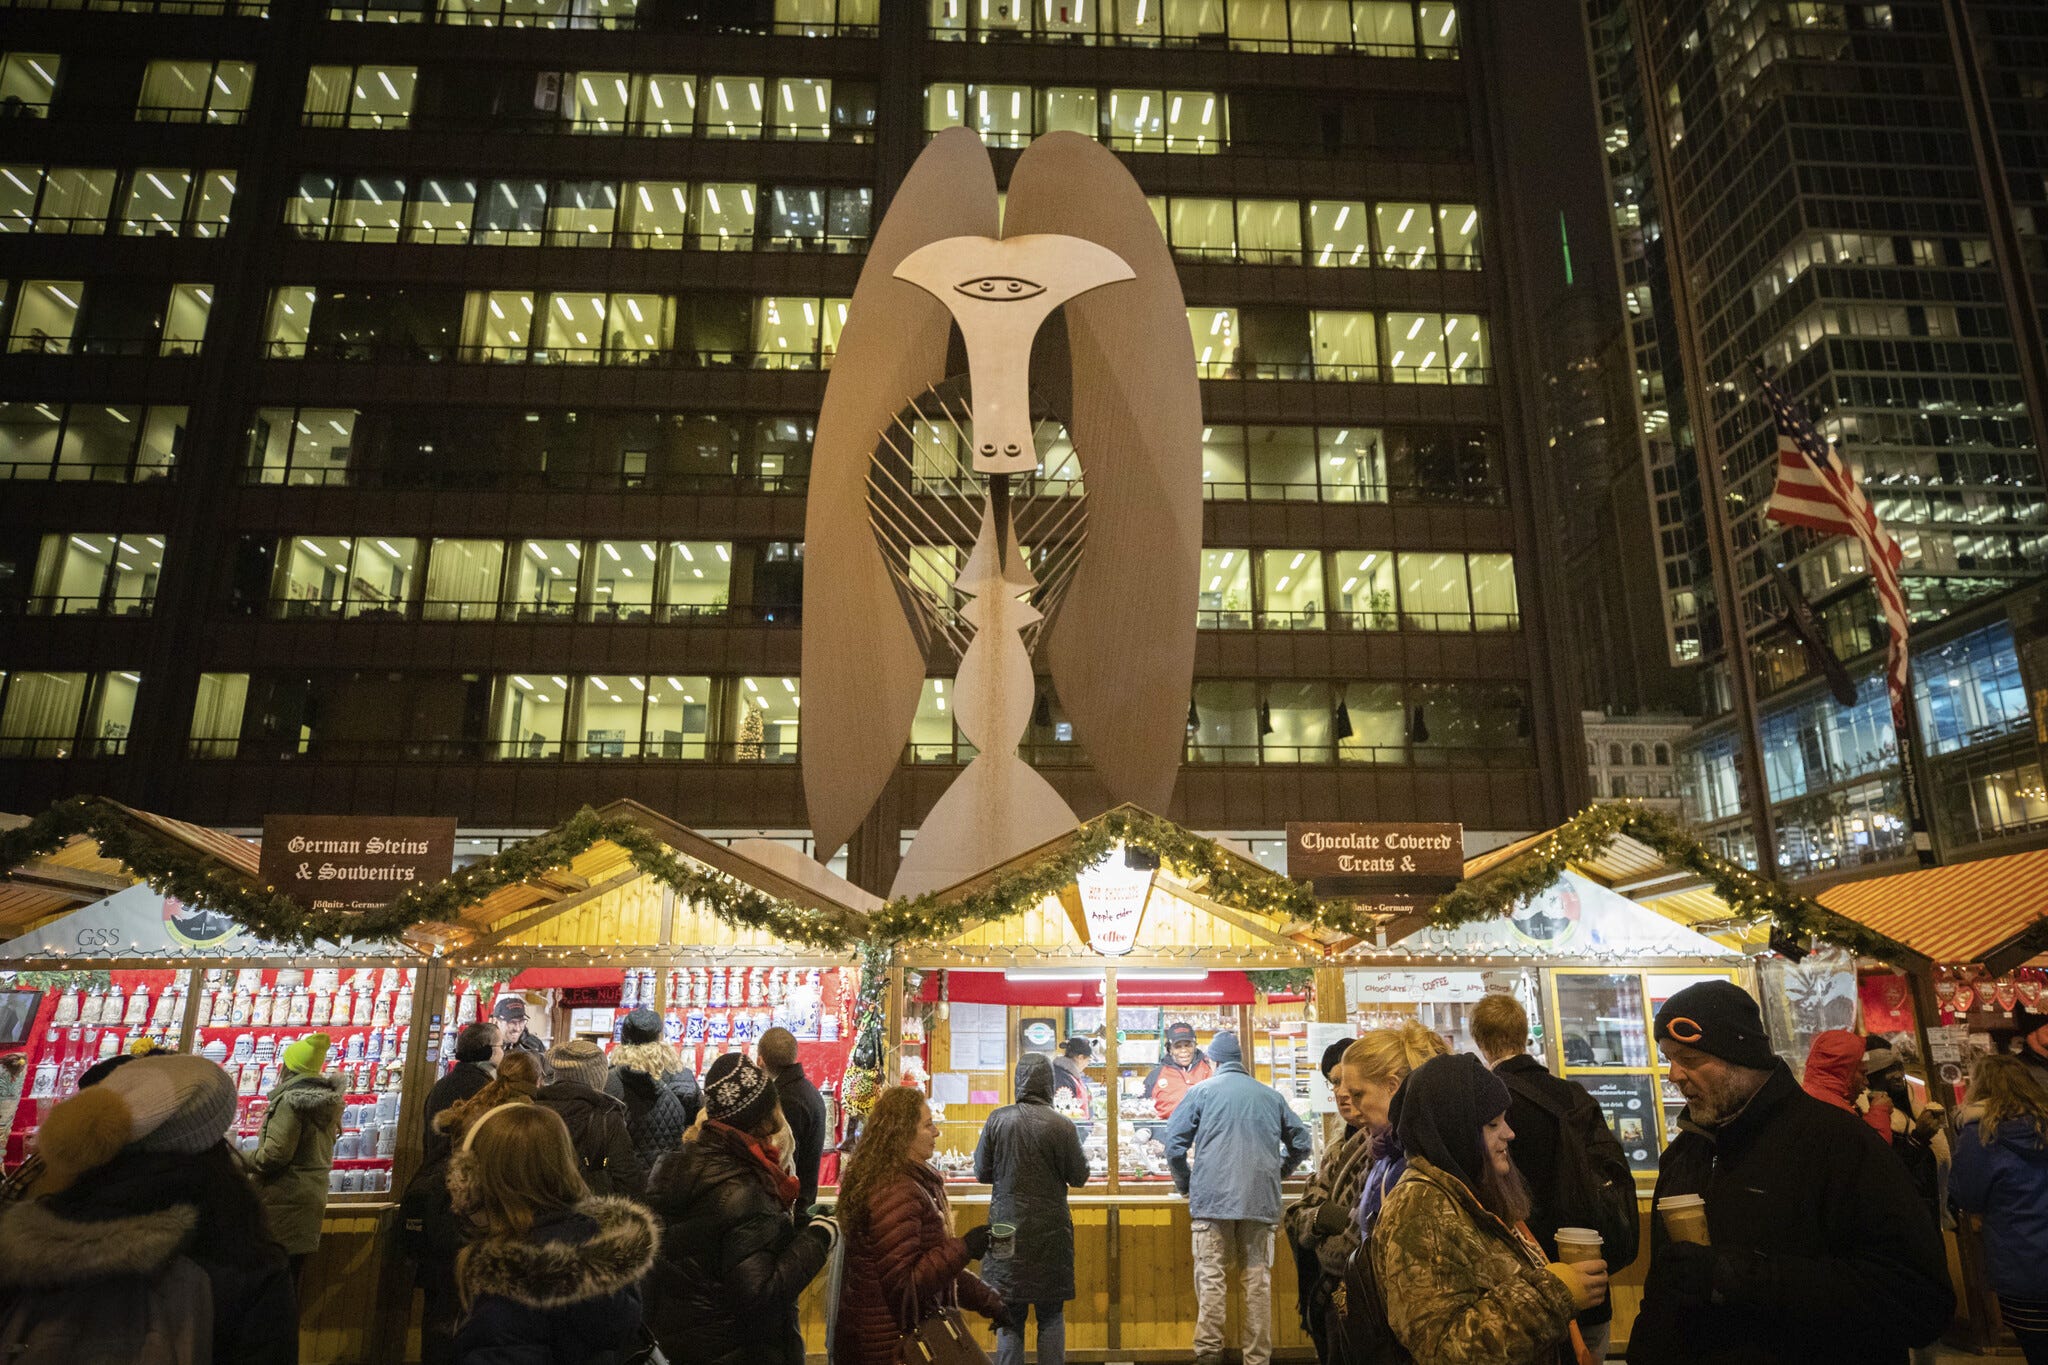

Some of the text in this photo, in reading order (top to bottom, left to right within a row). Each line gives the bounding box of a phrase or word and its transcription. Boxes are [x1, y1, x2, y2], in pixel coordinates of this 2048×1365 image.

[287, 835, 429, 855] German Steins
[1300, 832, 1452, 851] Chocolate Covered
[1338, 854, 1416, 872] Treats &
[295, 862, 416, 881] & Souvenirs
[1379, 903, 1415, 914] Germany
[77, 928, 120, 946] GSS
[1097, 931, 1127, 942] coffee
[1377, 972, 1391, 981] HOT
[1422, 976, 1449, 991] COFFEE
[1364, 985, 1407, 993] CHOCOLATE
